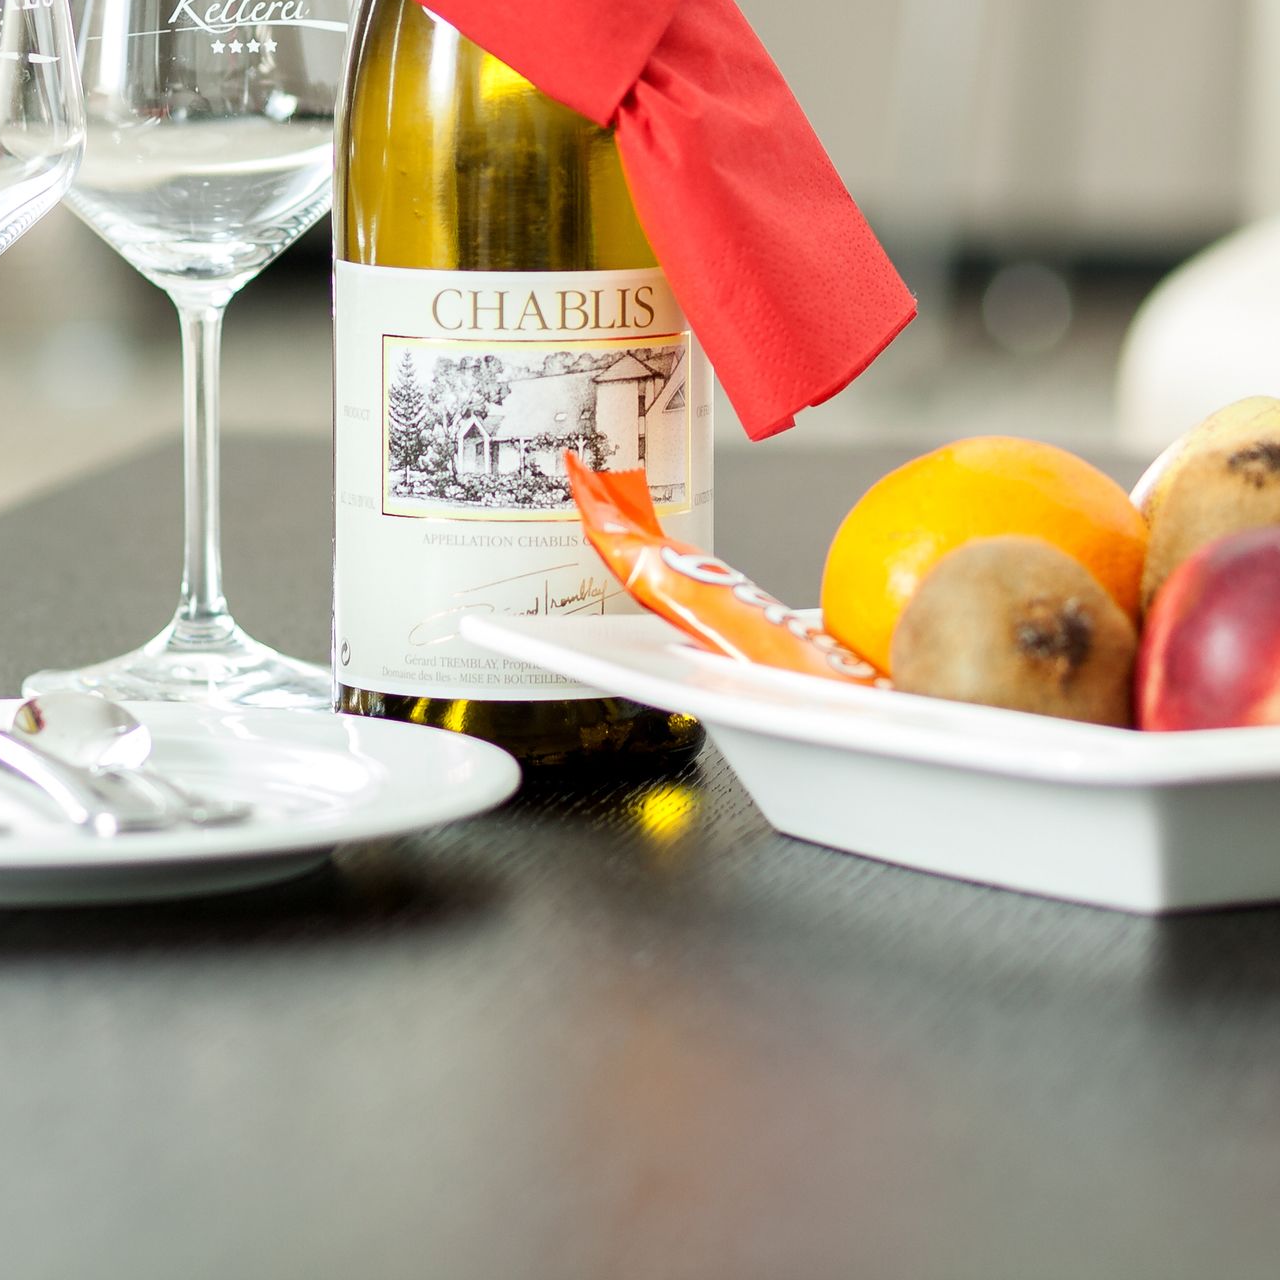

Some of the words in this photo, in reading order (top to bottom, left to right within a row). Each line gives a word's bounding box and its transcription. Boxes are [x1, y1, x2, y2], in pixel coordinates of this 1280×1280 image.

[432, 286, 656, 331] CHABLIS
[423, 533, 513, 547] APPELLATION
[518, 535, 578, 548] CHABLIS
[404, 654, 437, 667] Gérard
[439, 656, 499, 670] TREMBLAY,
[382, 666, 416, 680] Domaine
[418, 669, 433, 681] des
[460, 673, 483, 683] MISE
[487, 673, 500, 684] EN
[504, 674, 567, 685] BOUTEILLES
